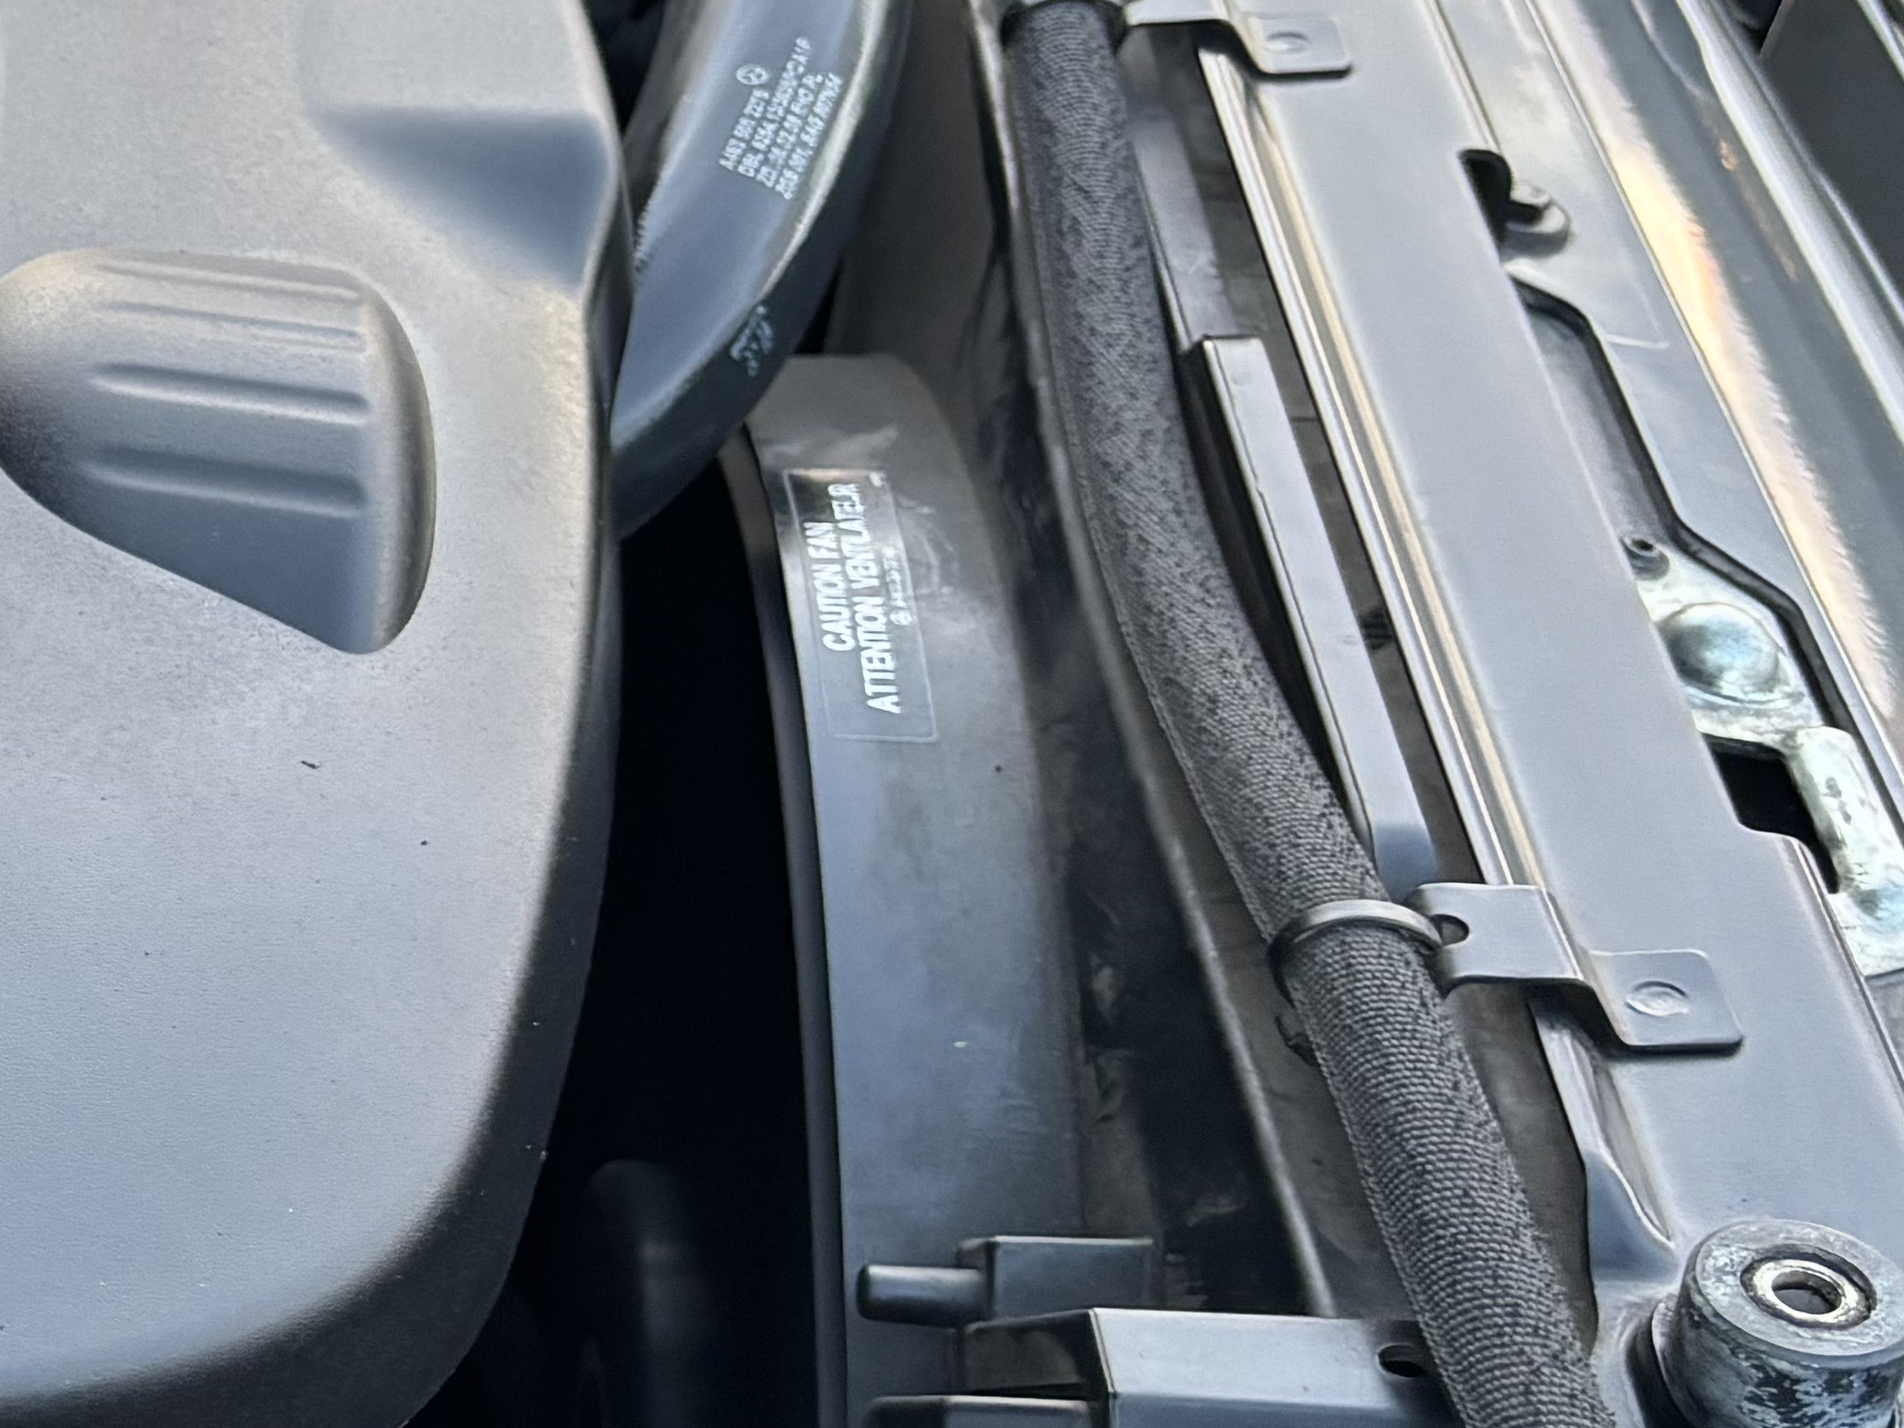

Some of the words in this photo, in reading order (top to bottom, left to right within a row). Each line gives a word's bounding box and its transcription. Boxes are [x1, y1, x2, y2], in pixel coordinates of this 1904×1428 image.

[803, 522, 841, 560] FAN
[811, 563, 855, 652] CAUTION
[851, 596, 902, 714] ATTENTION
